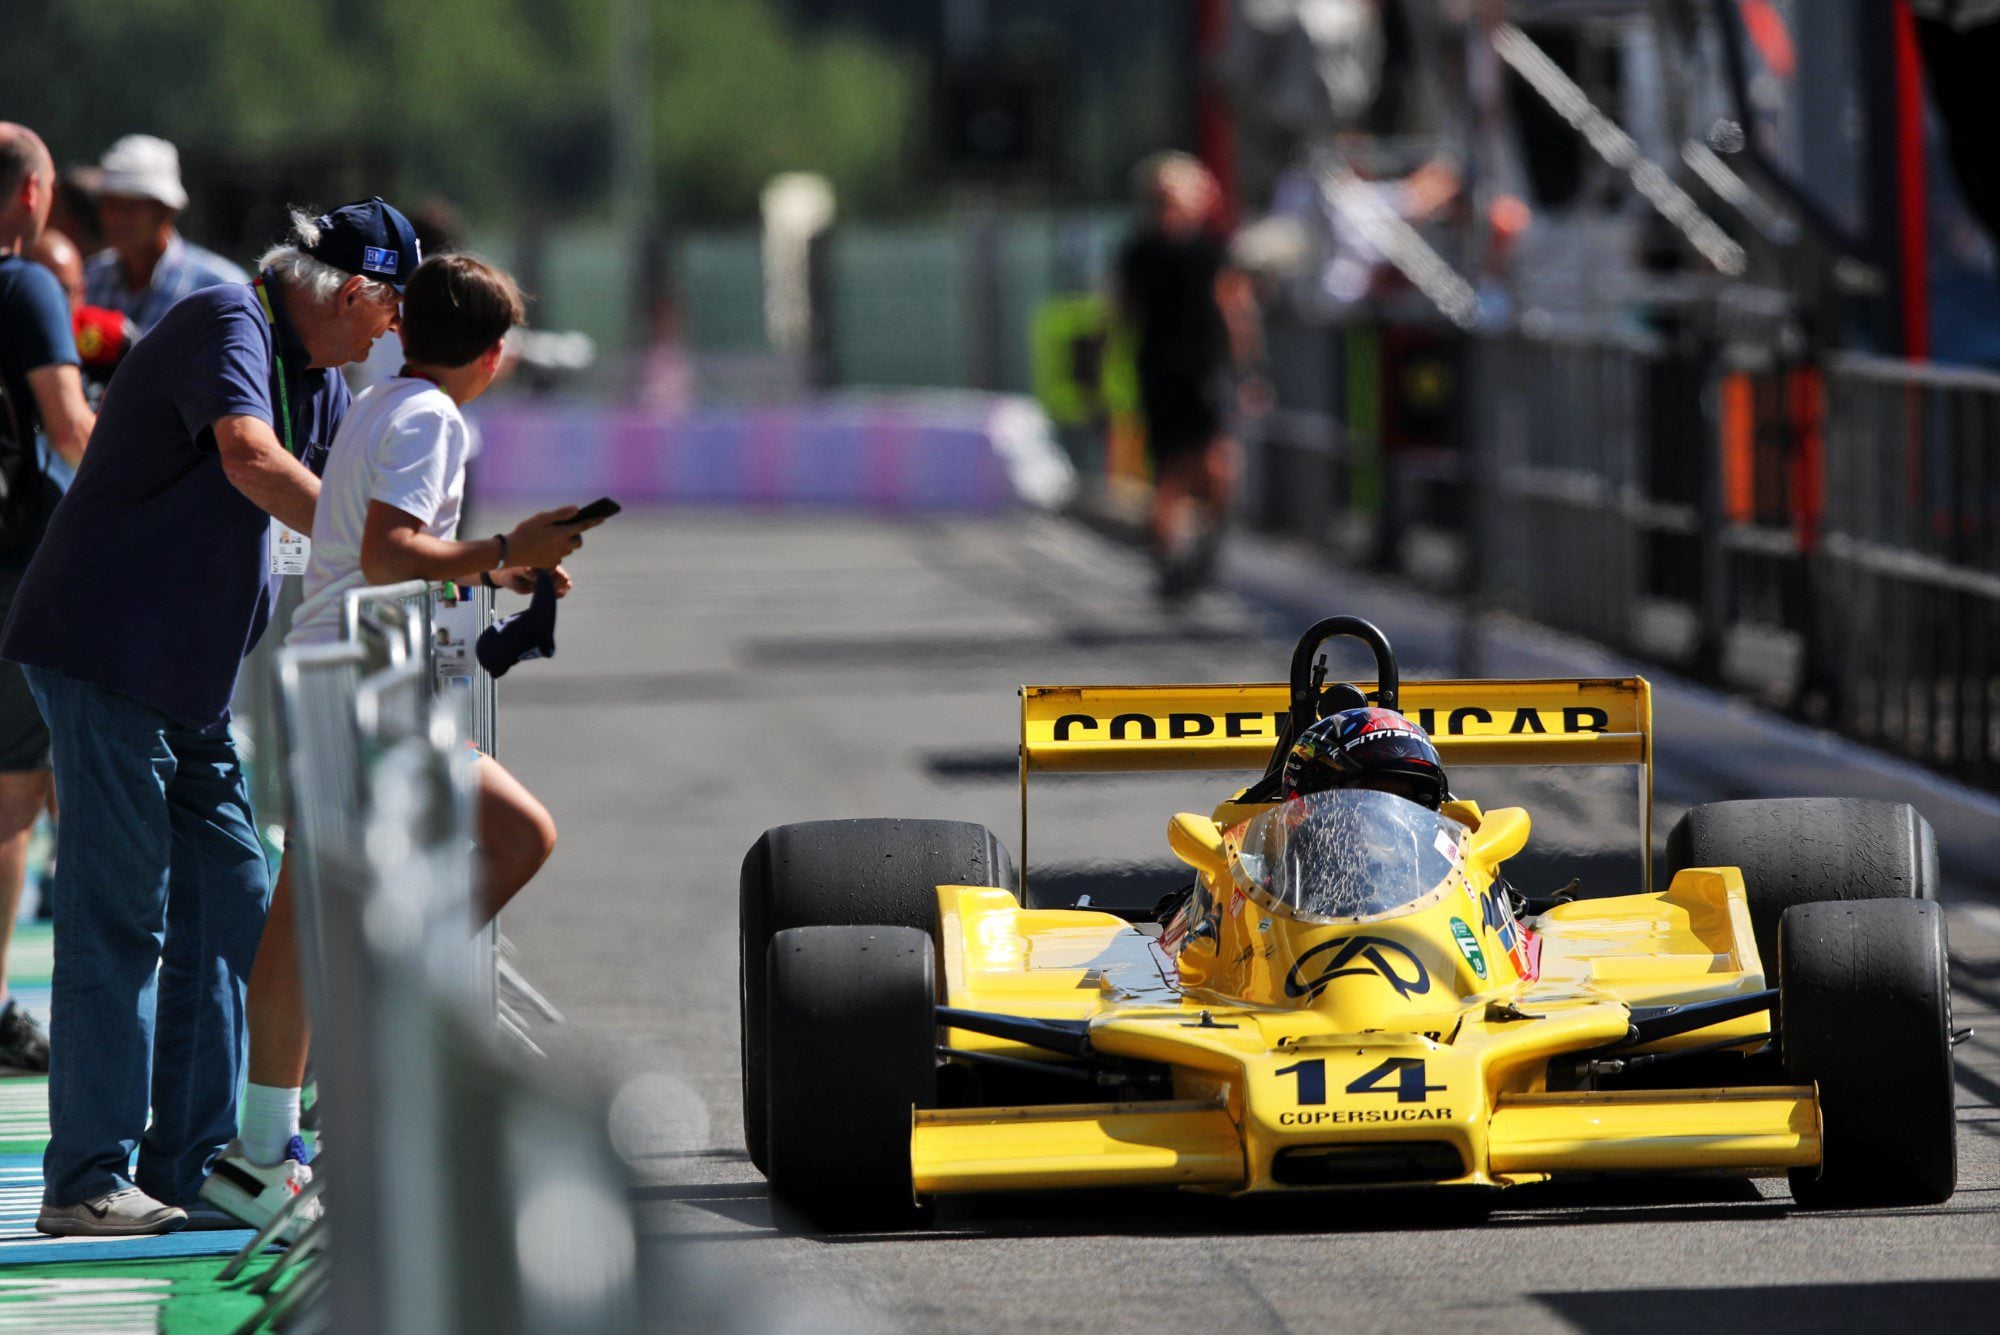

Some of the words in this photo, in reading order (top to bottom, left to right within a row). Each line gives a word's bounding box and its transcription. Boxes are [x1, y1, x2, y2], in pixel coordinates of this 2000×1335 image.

[1053, 706, 1609, 742] COPECAR
[1275, 1057, 1447, 1106] 14
[1279, 1108, 1452, 1126] COPERSUCAR
